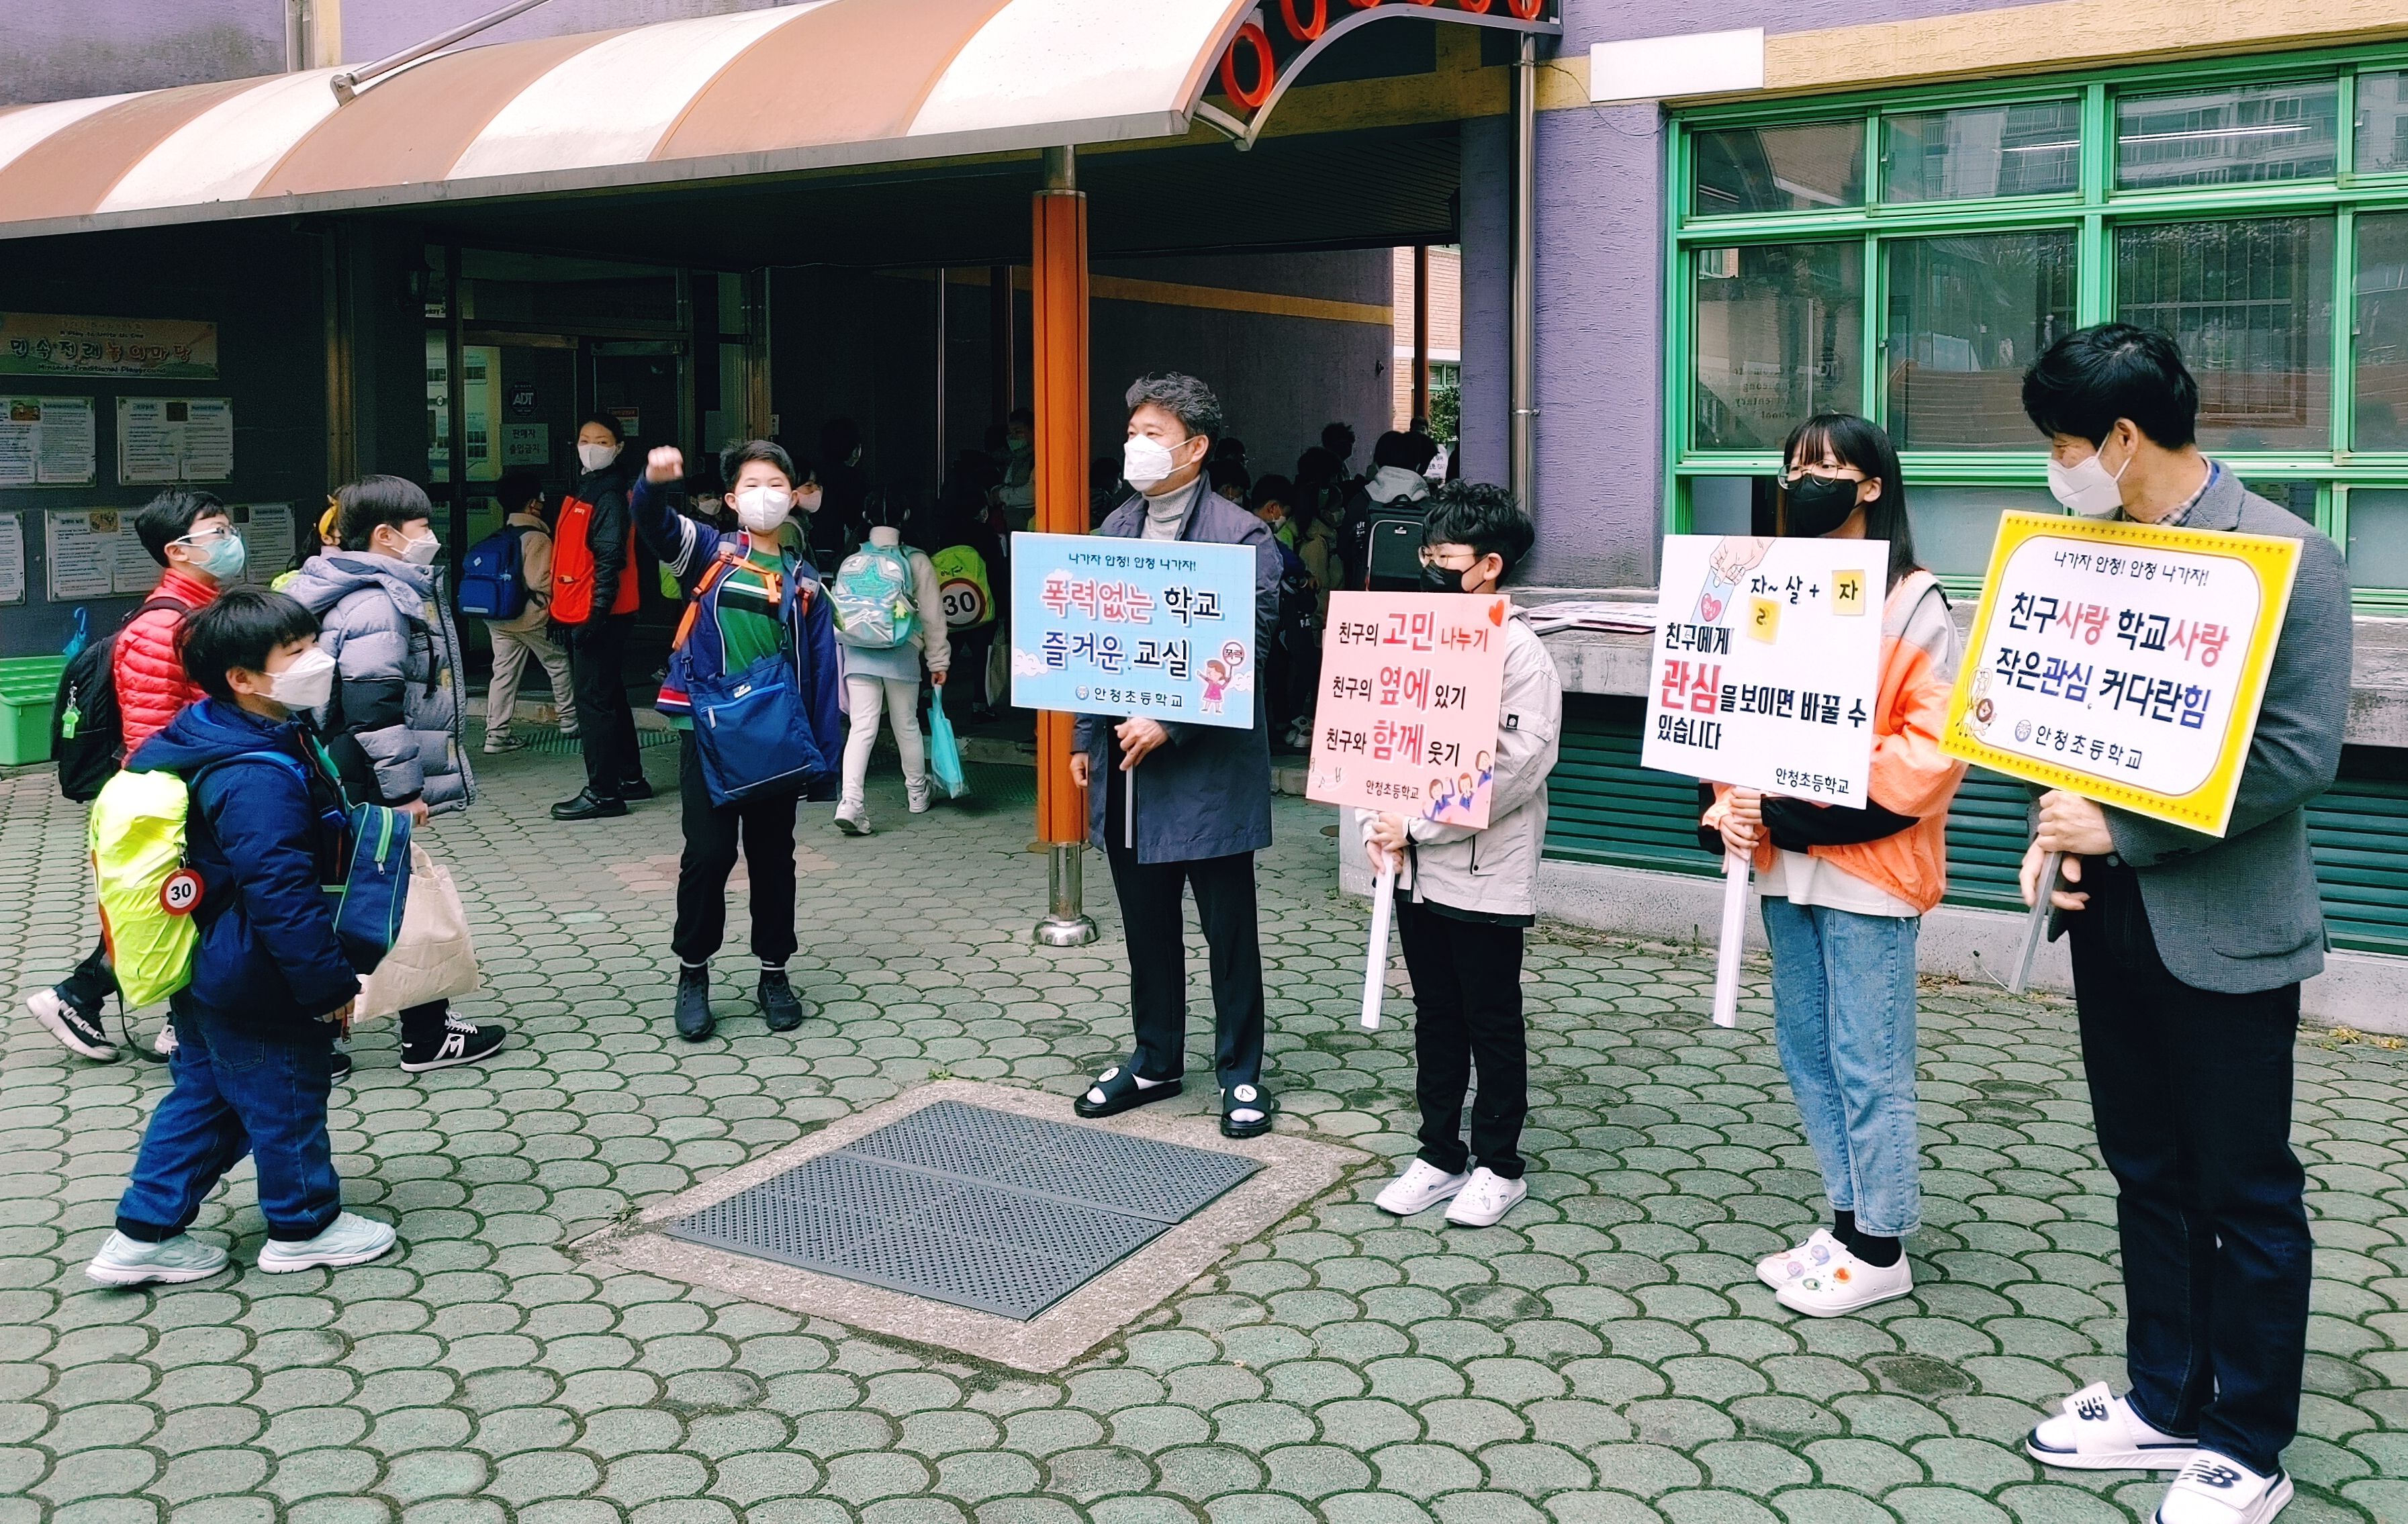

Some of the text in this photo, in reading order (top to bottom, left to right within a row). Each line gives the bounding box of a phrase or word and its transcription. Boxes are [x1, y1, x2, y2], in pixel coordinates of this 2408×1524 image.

[512, 392, 534, 406] ADT
[1068, 553, 1197, 572] 나가자 안청! 안청 나가자!
[2054, 551, 2210, 587] 나가자 안청! 안청 나가자!
[942, 591, 976, 616] 30
[1041, 578, 1221, 624] 폭력없는 학교
[1785, 575, 1803, 605] 살
[1839, 579, 1859, 601] 자
[1338, 610, 1490, 653] 친구의 고민 나누기
[1665, 622, 1733, 655] 친구에게
[2009, 591, 2230, 668] 친구사랑 학교사랑
[1041, 631, 1188, 678] 즐거운 교실
[1094, 687, 1183, 708] 안청초등학교
[1332, 665, 1467, 712] 친구의 옆에 있기
[1740, 683, 1796, 719] 보이면
[1800, 691, 1841, 725] 바꿀
[1847, 698, 1867, 729] 수
[1995, 646, 2212, 730] 작은관심 커다란힘
[1326, 718, 1461, 767] 친구와 함께 웃기
[1657, 714, 1722, 751] 있습니다
[2035, 725, 2143, 771] 안청초등학교
[1365, 779, 1420, 800] 안청초등학교
[1775, 767, 1850, 795] 안청초등학교
[171, 882, 192, 902] 30
